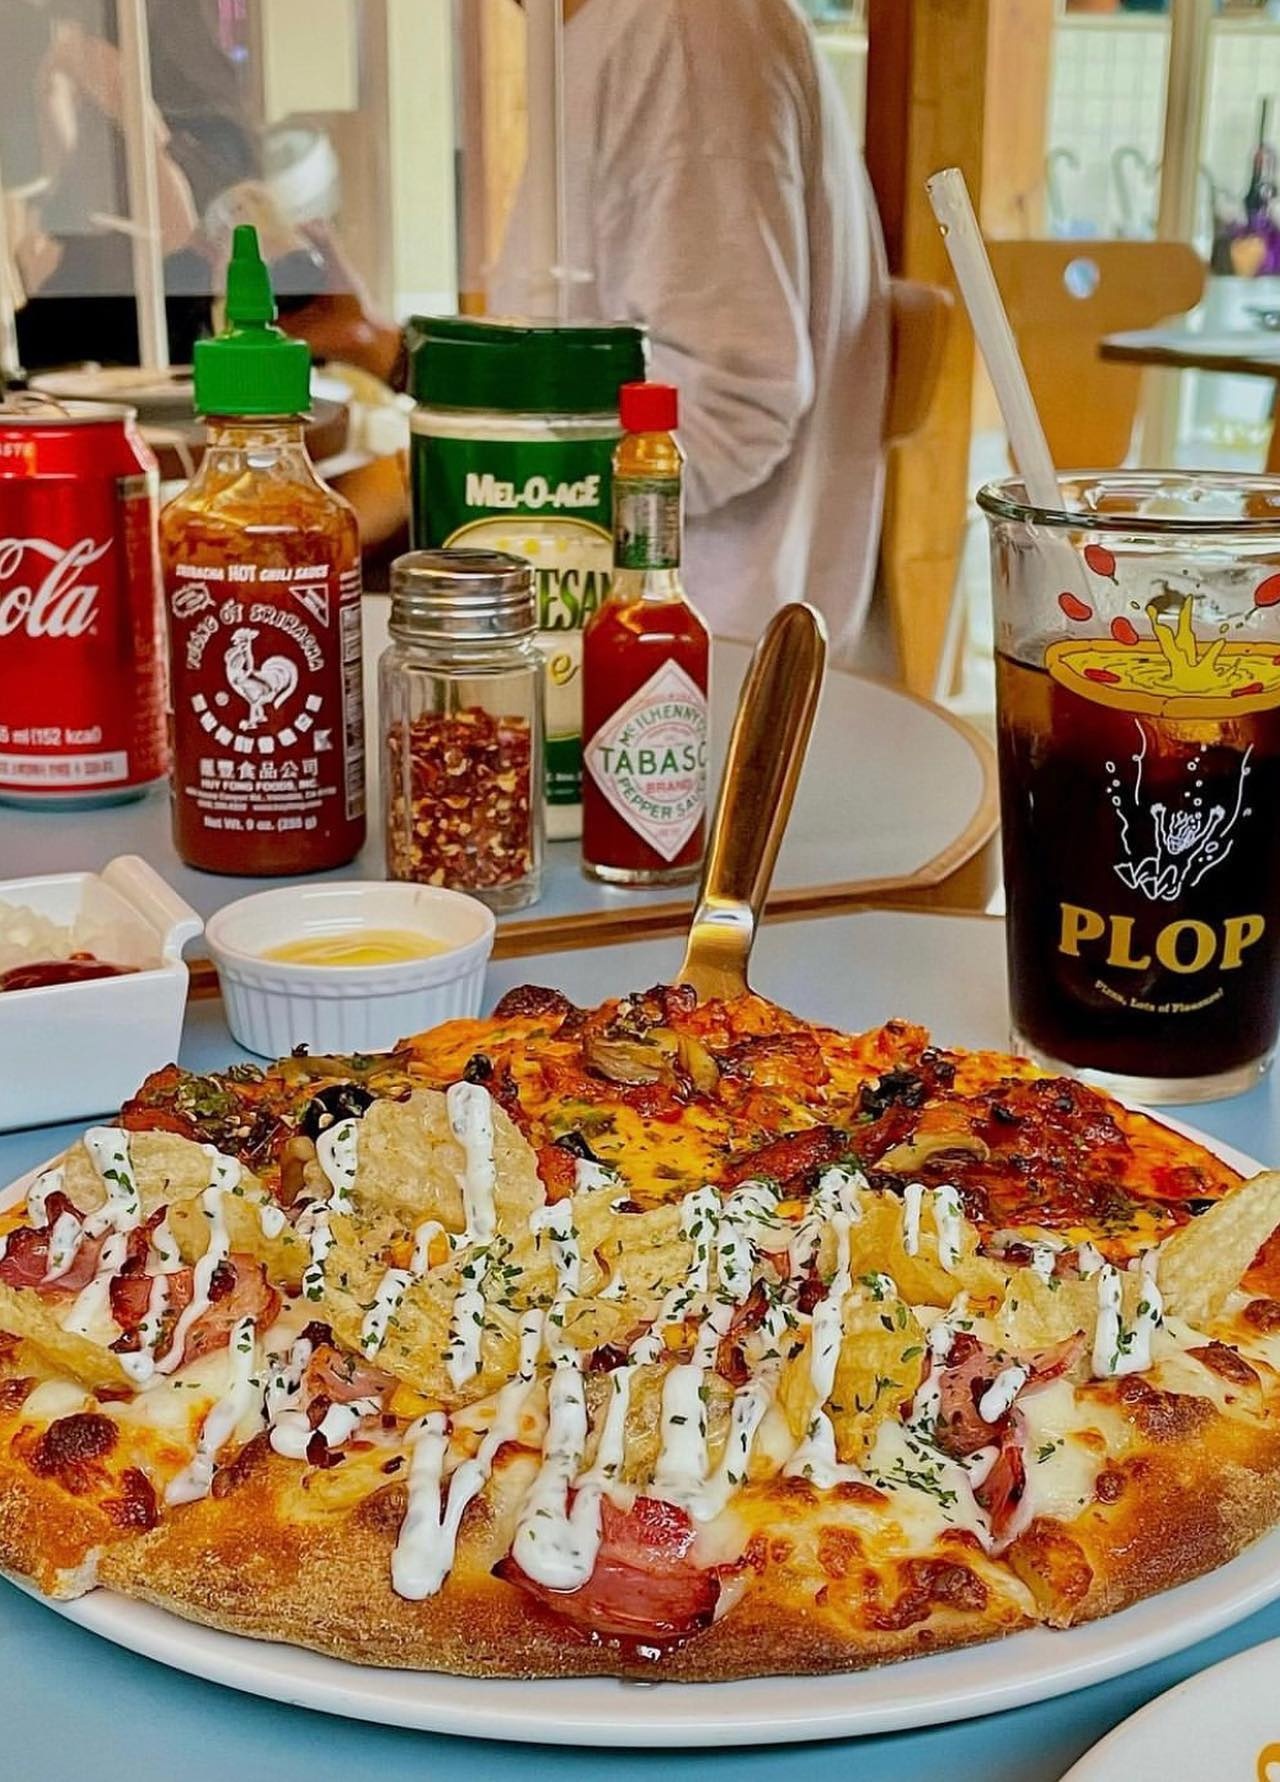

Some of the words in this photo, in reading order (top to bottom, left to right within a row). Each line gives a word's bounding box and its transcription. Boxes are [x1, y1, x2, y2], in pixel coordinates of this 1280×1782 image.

[228, 564, 257, 583] HOT
[249, 603, 325, 672] SRIRACHA
[598, 742, 707, 775] TABASC
[618, 776, 673, 820] PEPPER
[1058, 902, 1266, 974] PLOP
[1130, 997, 1155, 1012] Lots
[1158, 1003, 1170, 1013] of
